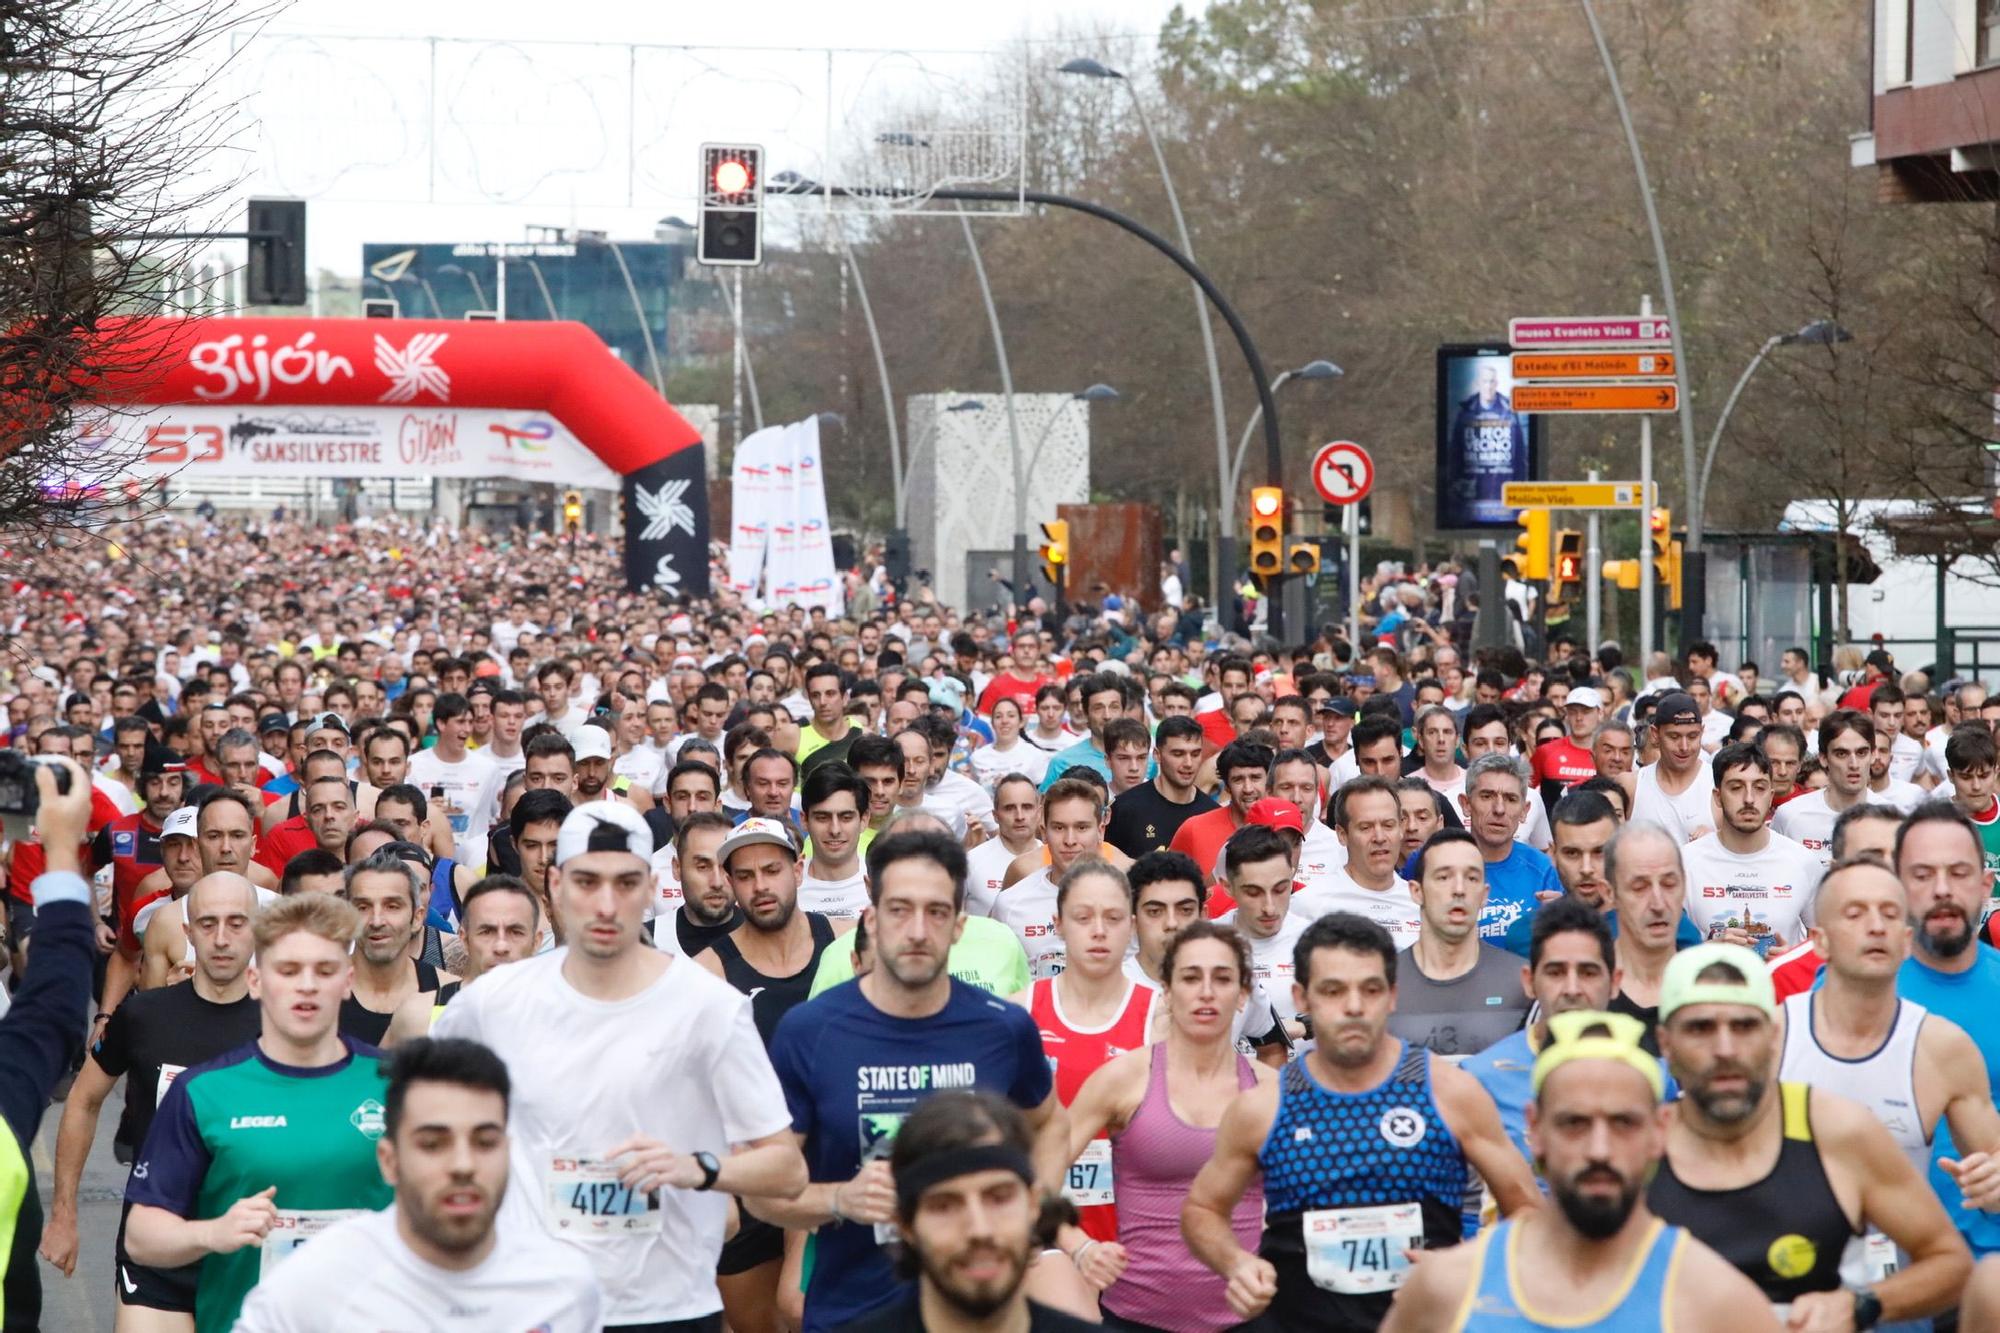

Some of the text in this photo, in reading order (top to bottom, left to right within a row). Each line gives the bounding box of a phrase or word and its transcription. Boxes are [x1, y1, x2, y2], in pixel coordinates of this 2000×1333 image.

[1554, 326, 1600, 337] Evaristo
[1603, 326, 1632, 336] Valle
[189, 331, 354, 401] gijón
[147, 425, 382, 464] 53 SANSILVESTRE
[662, 889, 682, 898] 53
[1703, 887, 1725, 898] 53
[1025, 926, 1046, 937] 53
[858, 1062, 976, 1090] STATE OF MIND
[230, 1115, 287, 1129] LEGEA
[571, 1182, 634, 1215] 4127
[1342, 1238, 1388, 1272] 741
